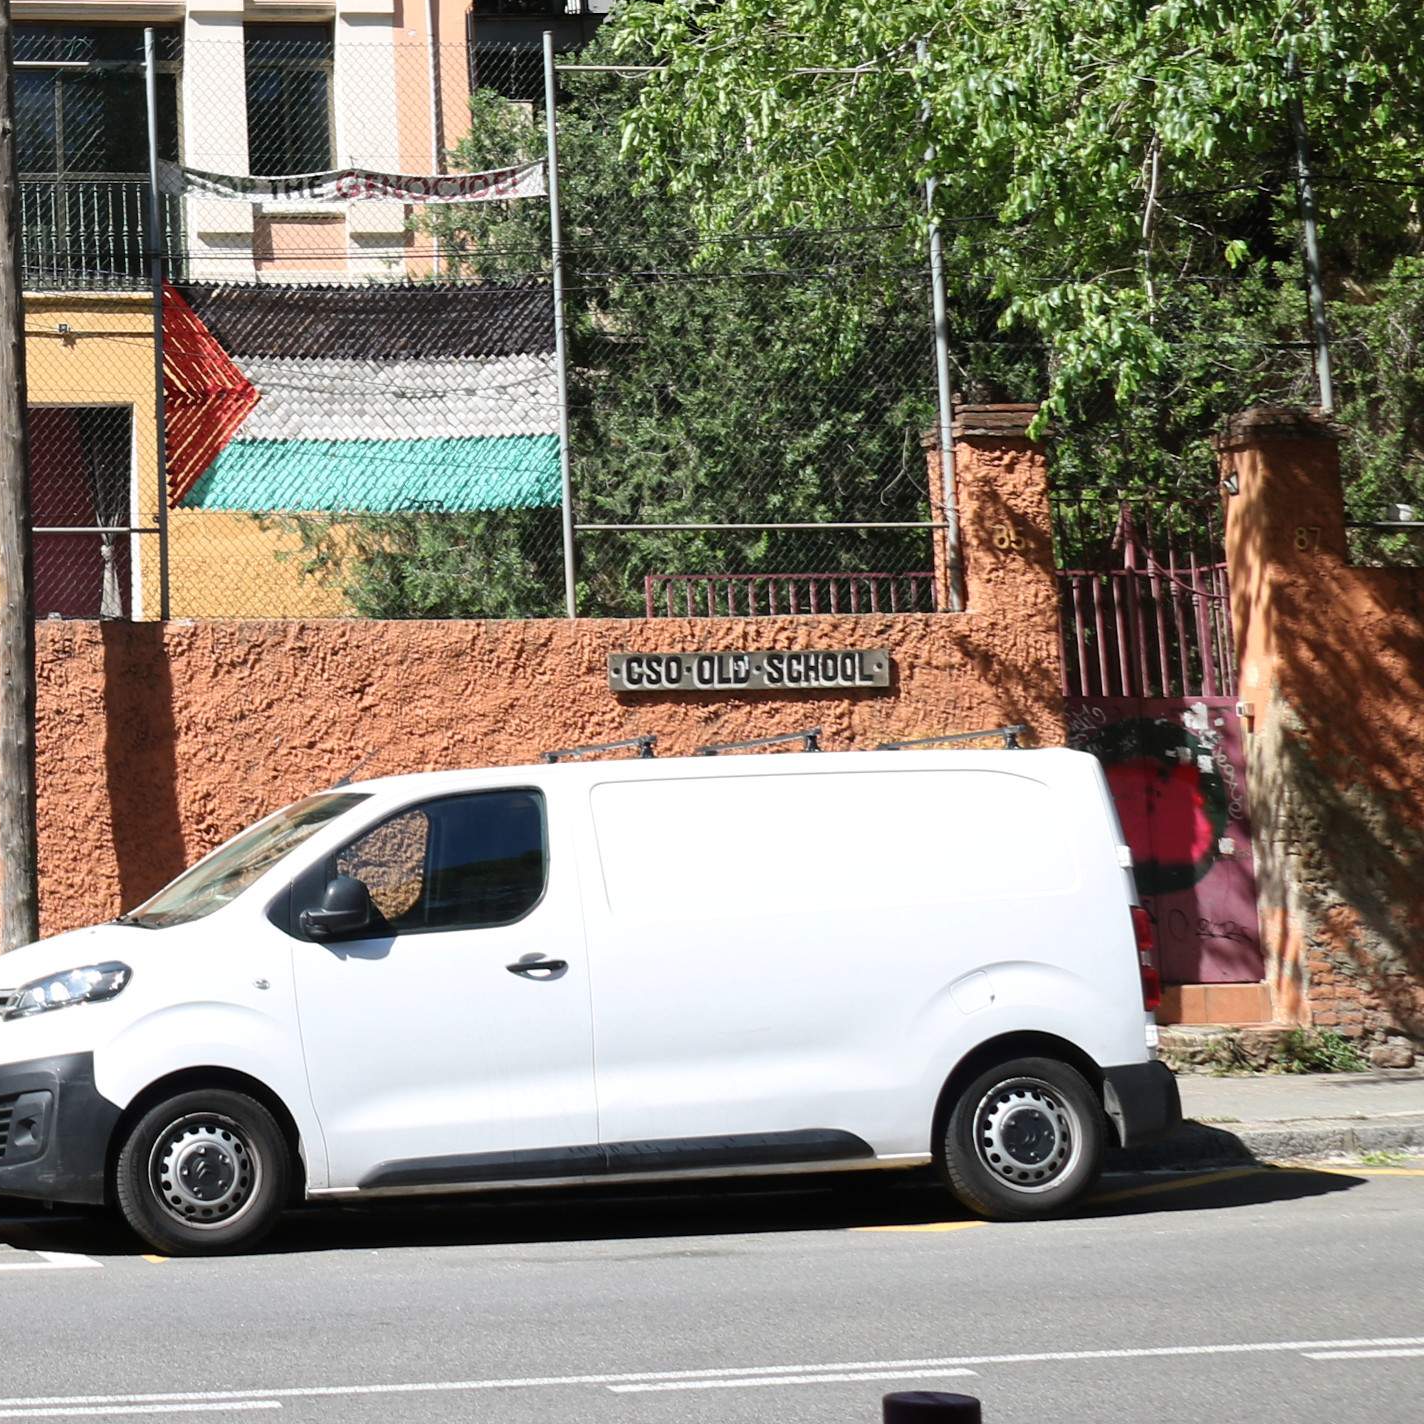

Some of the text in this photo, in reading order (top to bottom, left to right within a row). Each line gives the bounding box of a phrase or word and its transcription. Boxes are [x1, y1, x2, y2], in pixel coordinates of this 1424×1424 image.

[267, 175, 326, 201] THE
[992, 523, 1026, 551] 85
[1295, 526, 1321, 554] 87
[623, 651, 875, 689] CSO OLD SCHOOL
